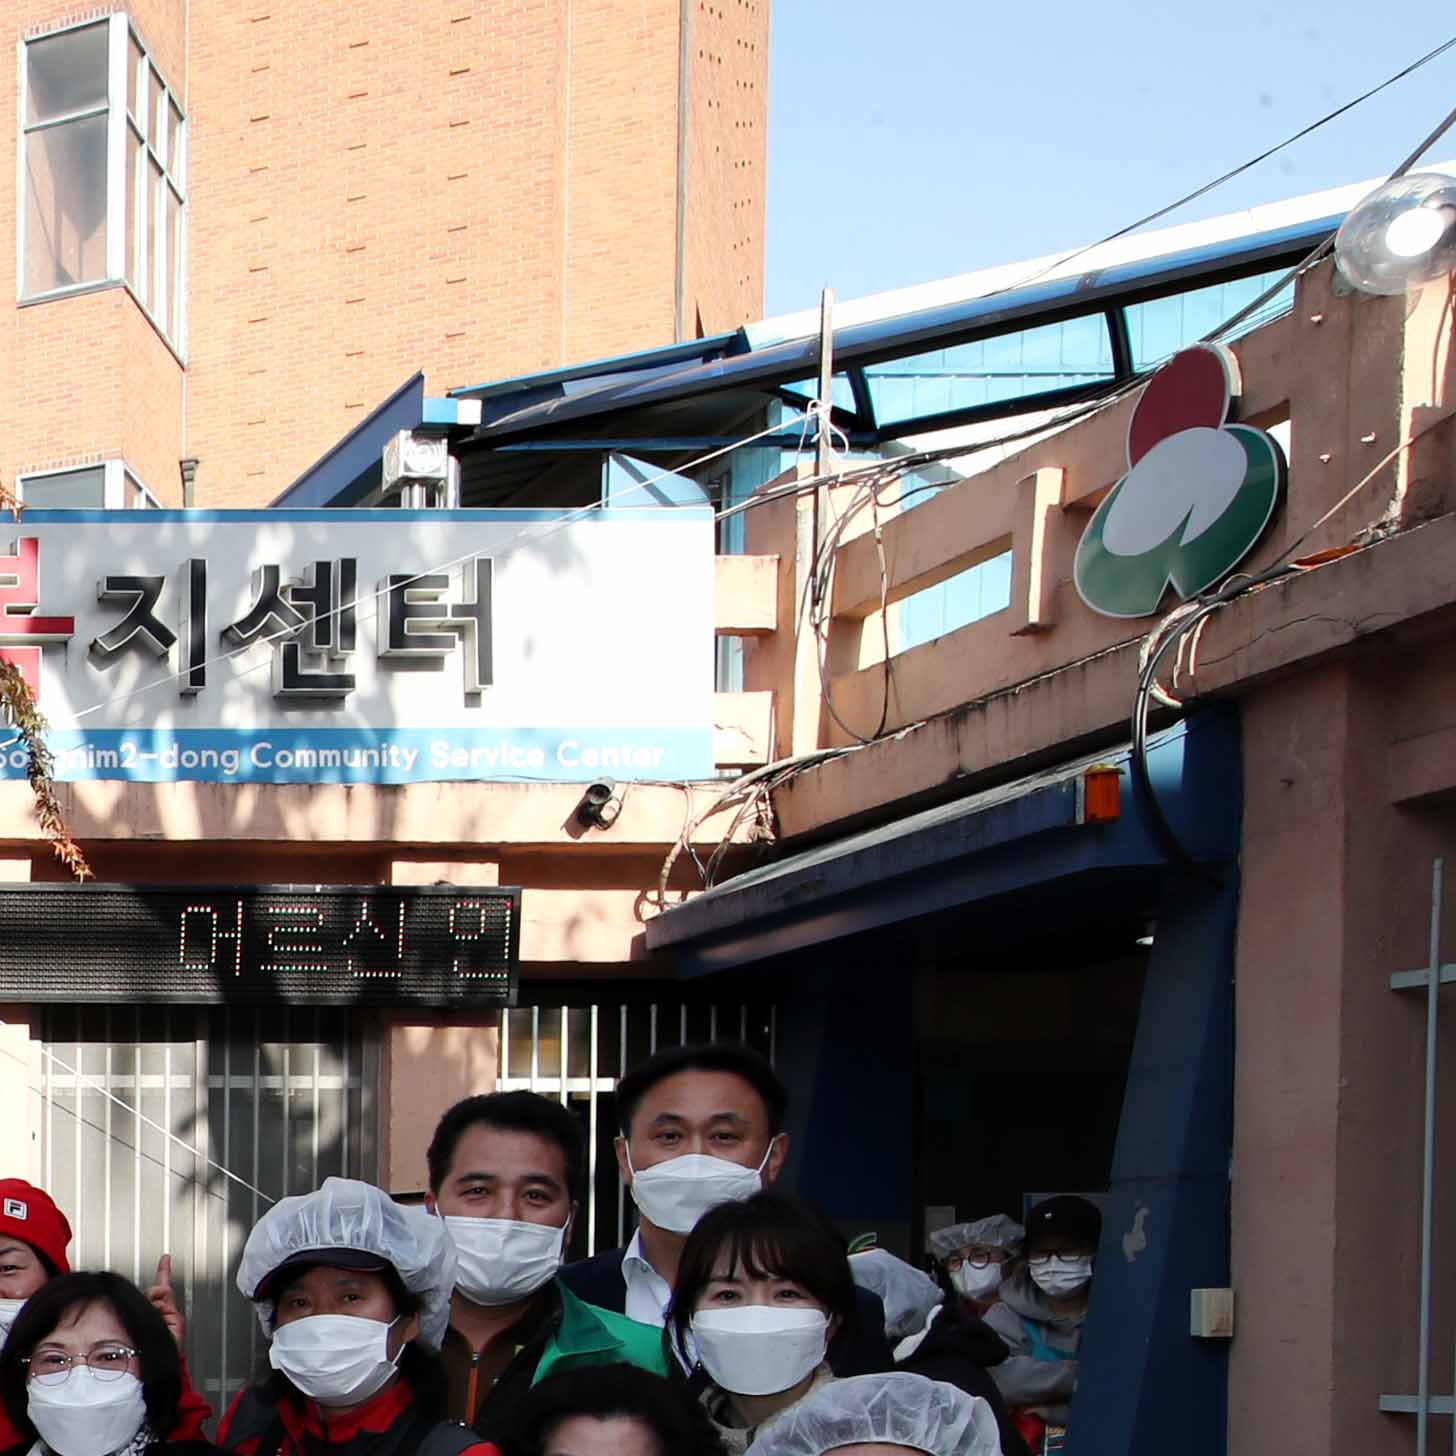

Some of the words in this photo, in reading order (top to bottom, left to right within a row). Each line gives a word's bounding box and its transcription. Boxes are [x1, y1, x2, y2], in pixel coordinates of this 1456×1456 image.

[249, 741, 419, 772] Community
[431, 740, 545, 769] Service
[557, 740, 666, 769] Center
